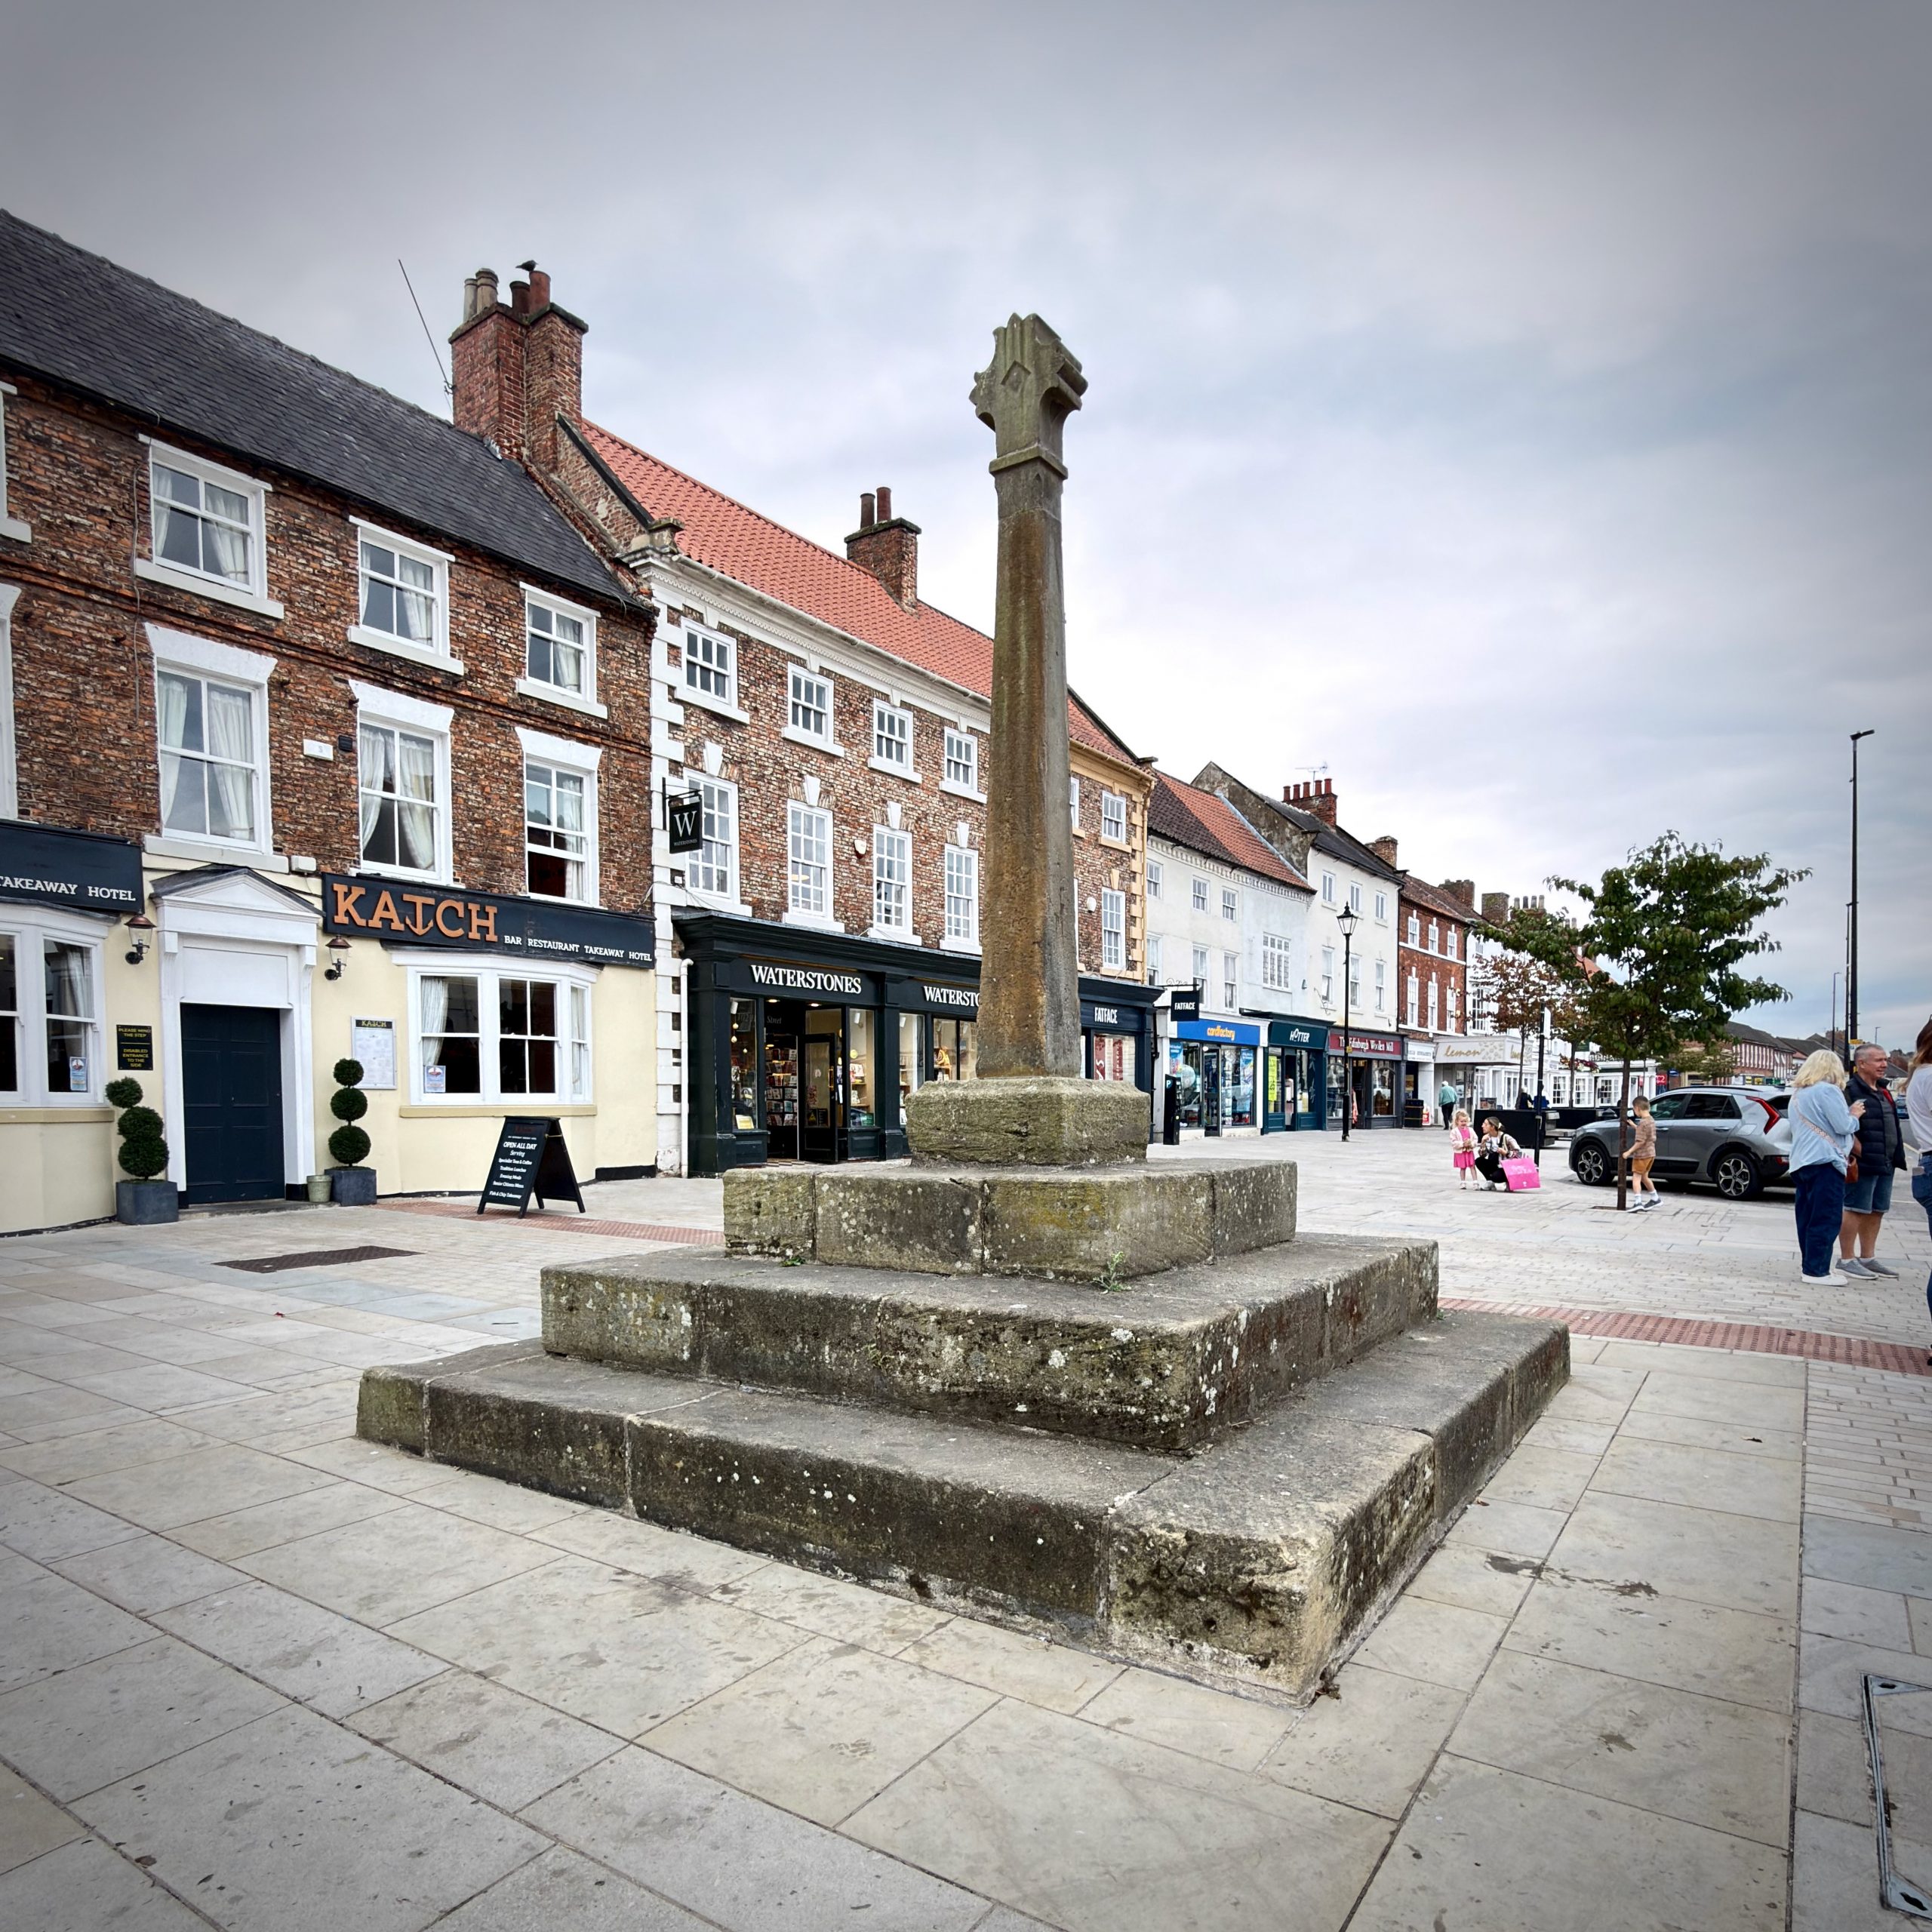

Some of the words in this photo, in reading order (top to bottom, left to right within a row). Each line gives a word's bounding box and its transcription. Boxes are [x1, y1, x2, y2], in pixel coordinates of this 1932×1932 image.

[674, 811, 697, 837] W
[88, 886, 137, 901] HOTEL
[333, 883, 498, 943] KATCH
[504, 935, 522, 945] BAR
[528, 938, 580, 952] RESTAURANT
[584, 946, 624, 958] TAKEAWAY
[629, 952, 652, 961] HOTEL
[751, 964, 862, 994] WATERSTONES
[1174, 1002, 1195, 1011] FATFACE
[1094, 1007, 1118, 1024] FATFACE
[1207, 1025, 1235, 1041] cardfactory
[1290, 1028, 1310, 1042] HOTTER
[1444, 1044, 1481, 1057] lemon
[509, 1149, 525, 1158] Serving
